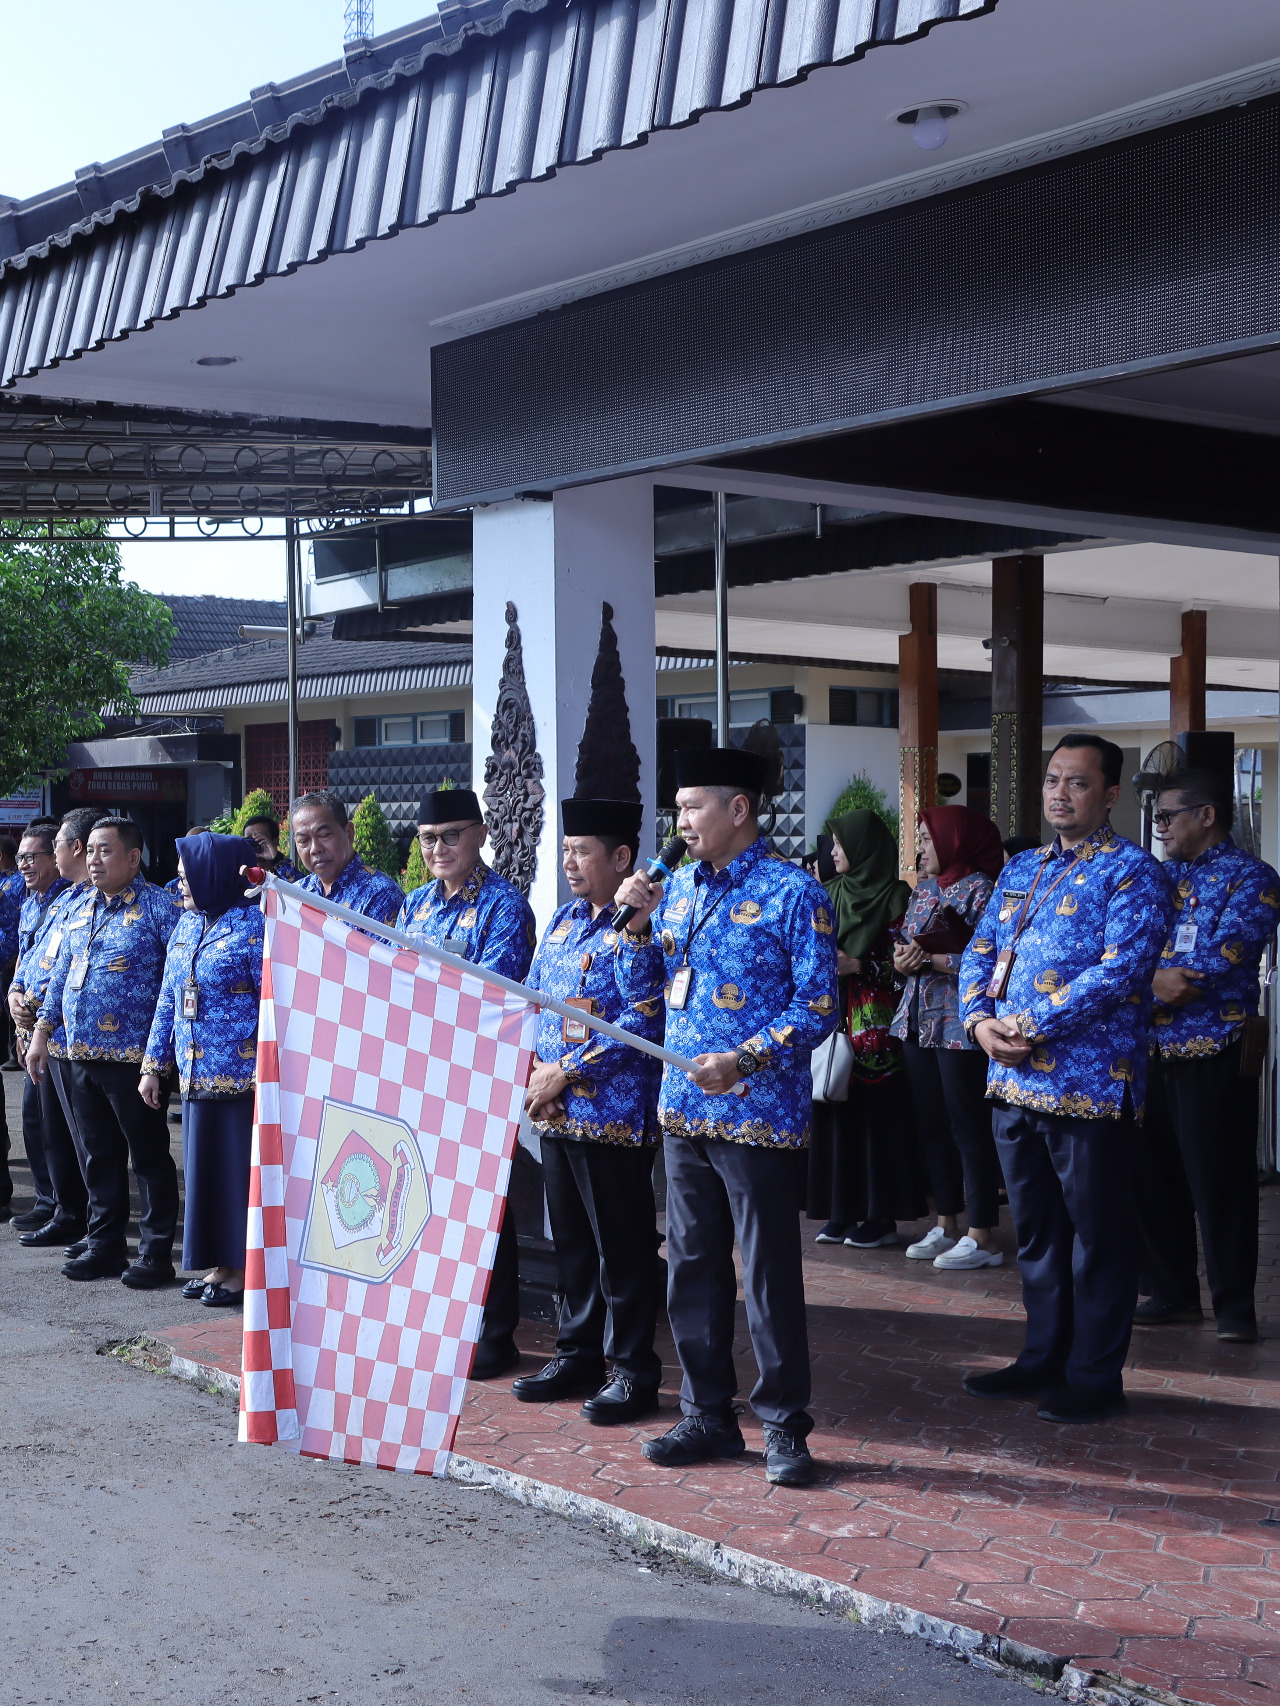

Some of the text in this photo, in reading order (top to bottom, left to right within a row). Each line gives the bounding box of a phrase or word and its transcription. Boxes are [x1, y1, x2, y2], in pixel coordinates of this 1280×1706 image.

[93, 771, 153, 781] ANDA MEMASUKI
[87, 781, 106, 790] ZONA
[132, 781, 158, 791] PUNGLI
